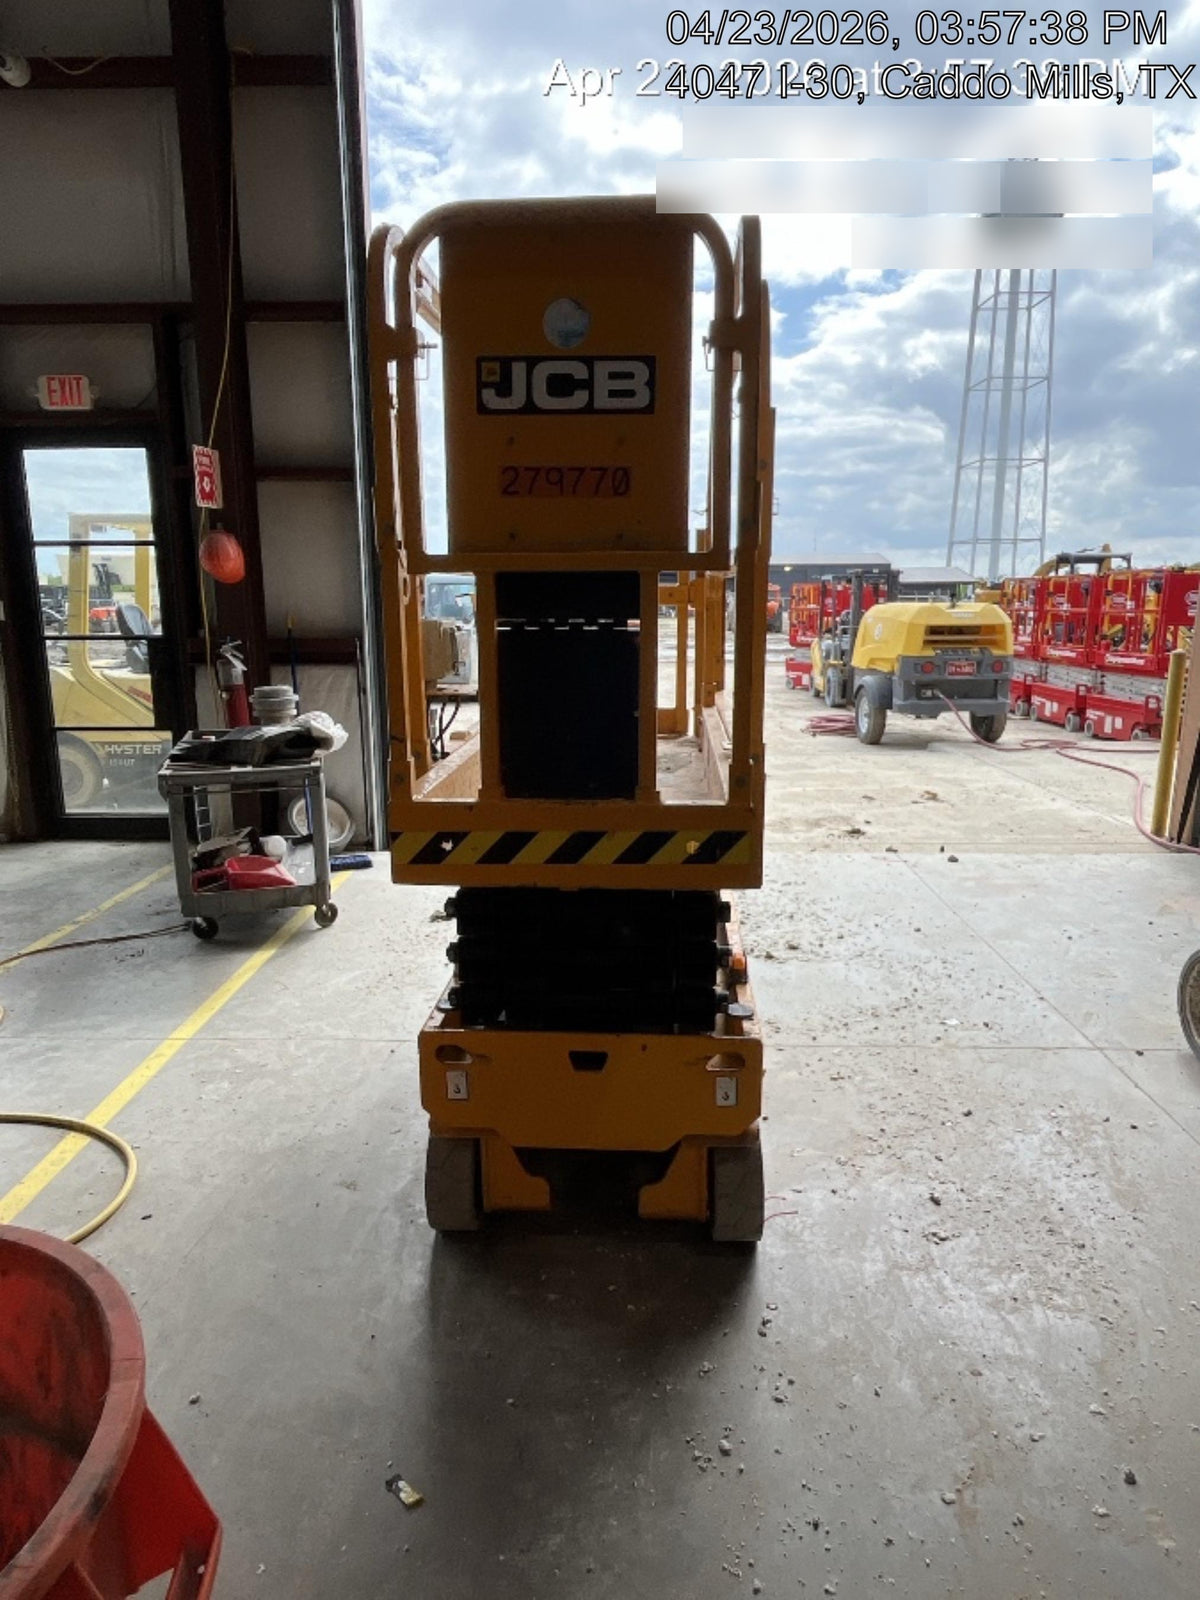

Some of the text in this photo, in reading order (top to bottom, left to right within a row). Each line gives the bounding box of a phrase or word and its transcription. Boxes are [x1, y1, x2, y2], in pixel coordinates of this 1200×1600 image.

[46, 375, 83, 407] EXIT
[481, 360, 651, 410] JCB
[501, 466, 632, 496] 279770
[105, 744, 162, 755] HYSTER
